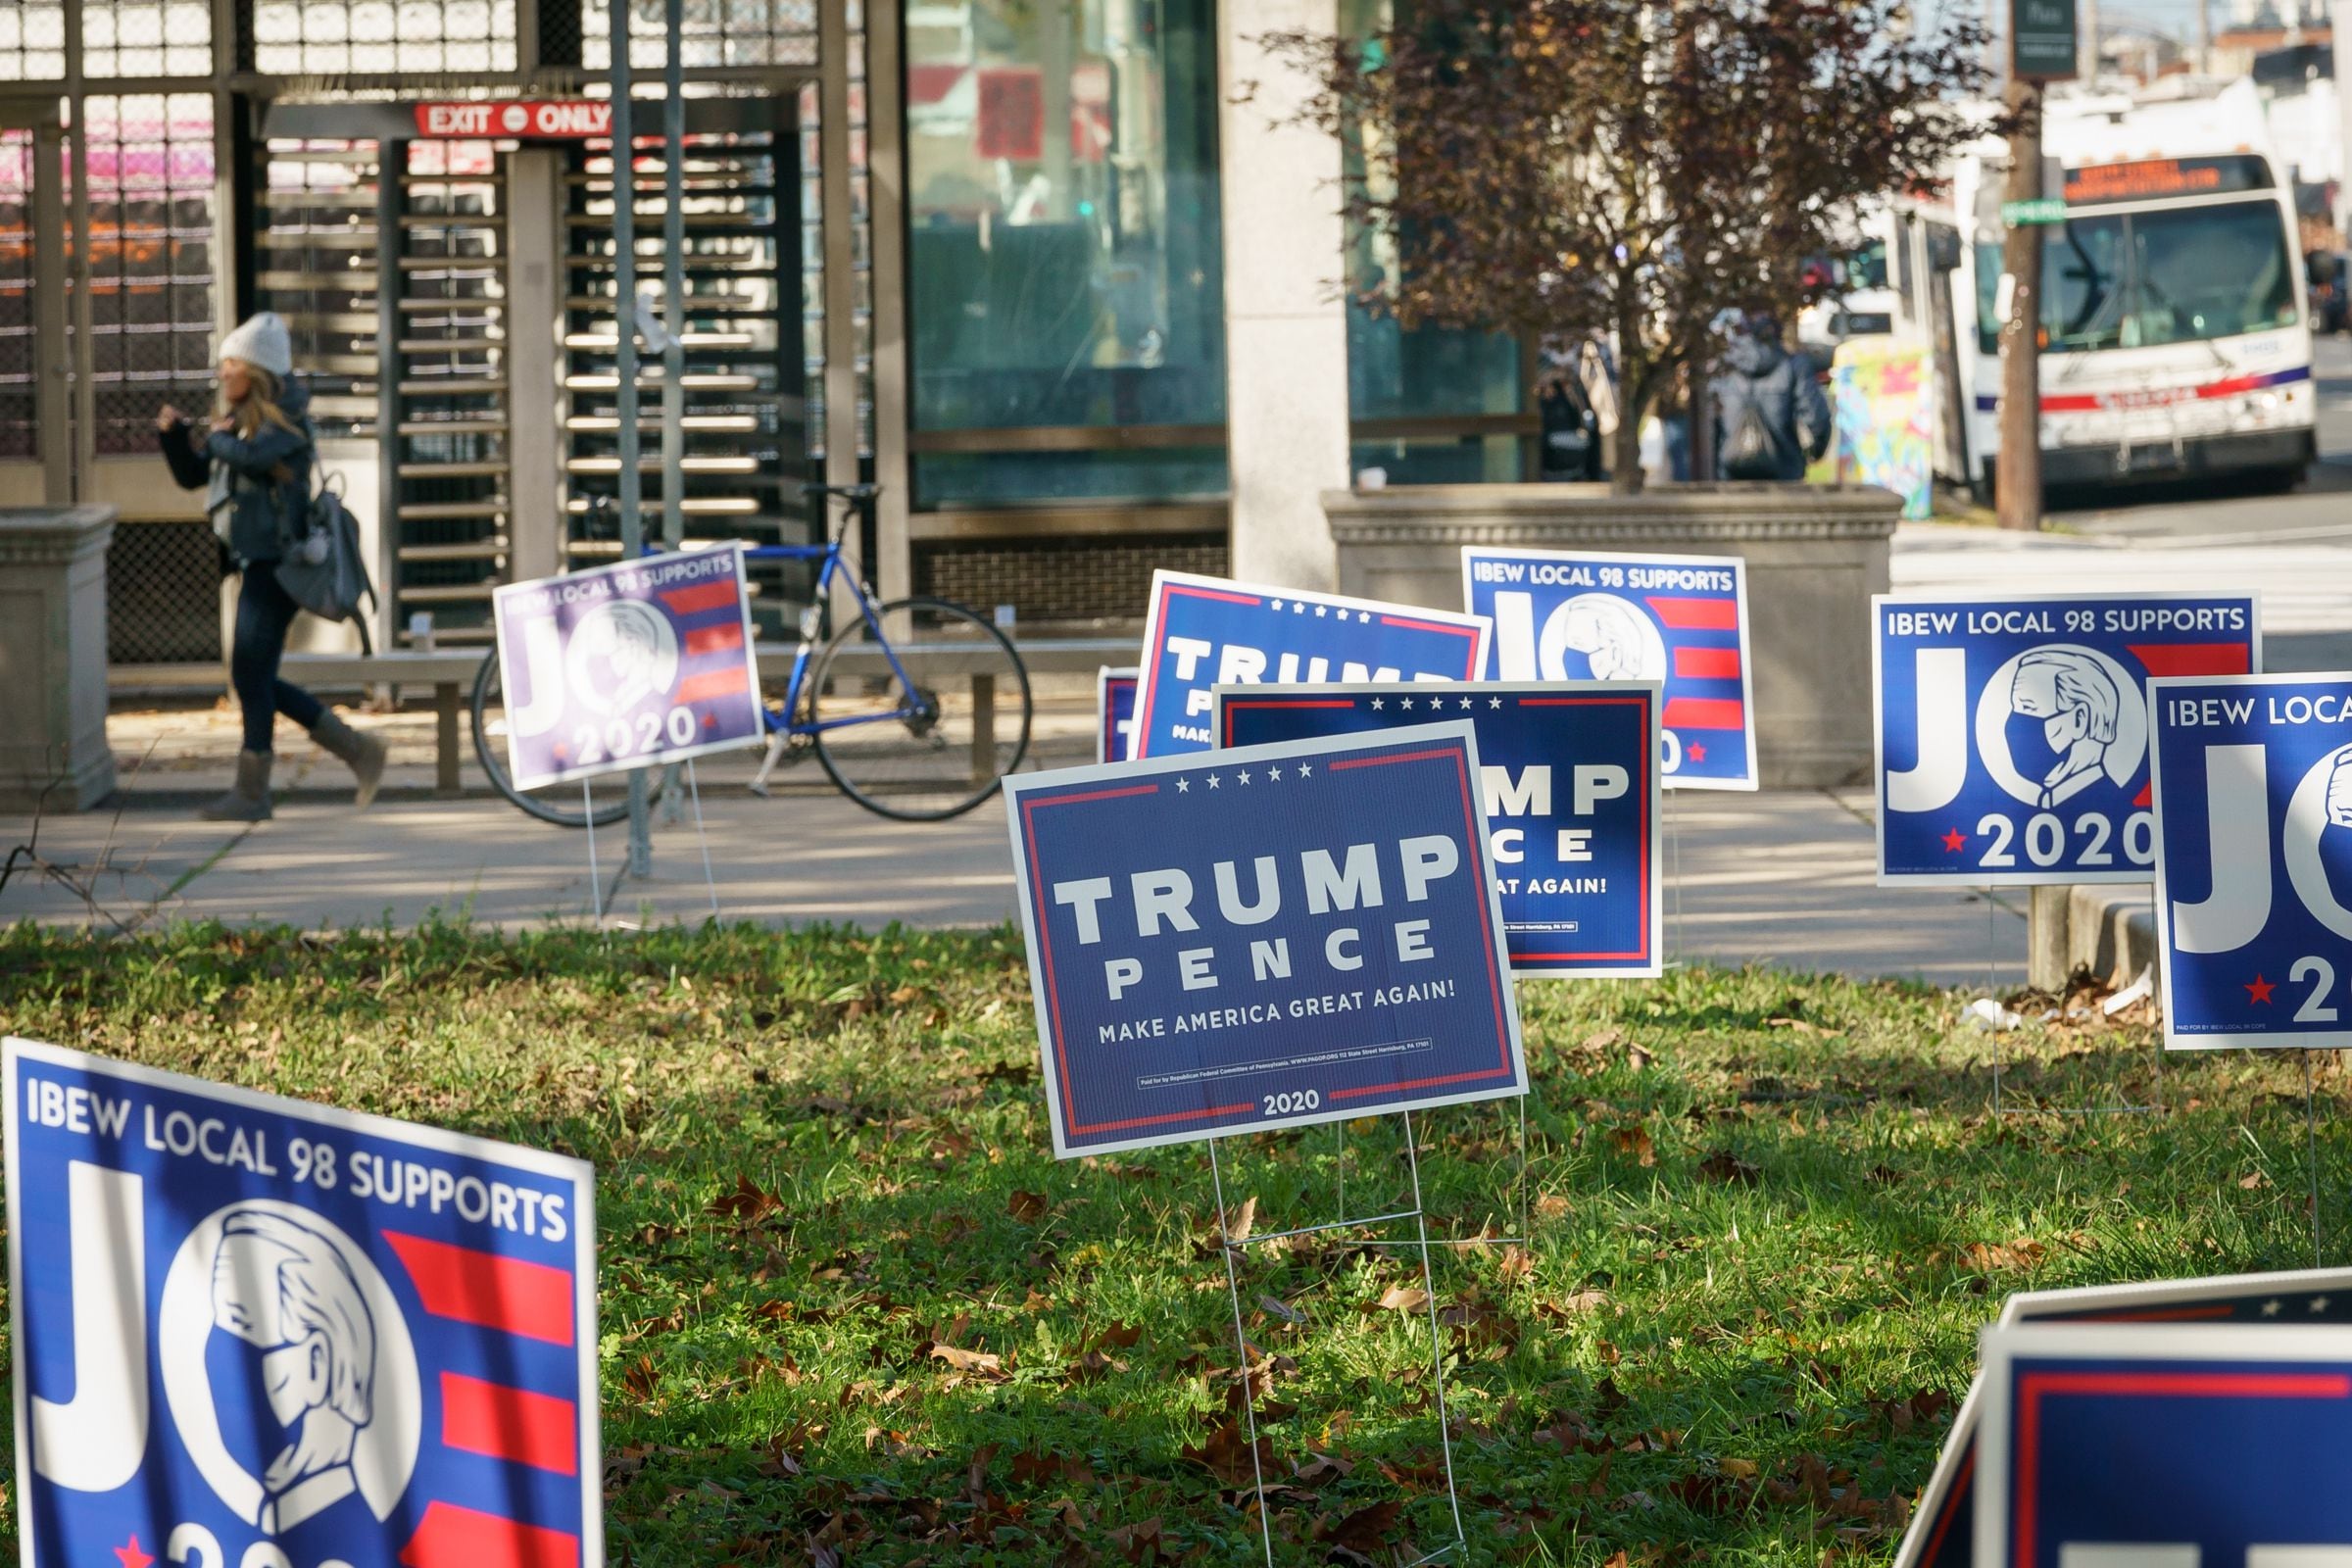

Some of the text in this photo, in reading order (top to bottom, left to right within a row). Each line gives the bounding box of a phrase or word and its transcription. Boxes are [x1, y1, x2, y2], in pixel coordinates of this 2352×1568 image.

[428, 104, 612, 133] EXIT ONLY
[554, 580, 612, 606] LOCAL
[641, 554, 733, 588] SUPPORTS
[1474, 562, 1734, 592] IBEW LOCAL 98 SUPPORTS
[1888, 608, 2245, 636] IBEW LOCAL 98 SUPPORTS
[2169, 695, 2352, 727] IBEW LOCA
[573, 706, 696, 765] 2020
[1172, 724, 1212, 744] MAK
[1976, 811, 2156, 867] 2020
[1054, 834, 1459, 945] TRUMP
[1527, 878, 1607, 895] AGAIN!
[1104, 919, 1435, 1001] PENCE
[1099, 980, 1456, 1045] MAKE AMERICA GREAT AGAIN!
[1200, 1069, 1220, 1078] Federal
[1263, 1090, 1321, 1115] 2020
[27, 1077, 568, 1244] IBEW LOCAL 98 SUPPORTS
